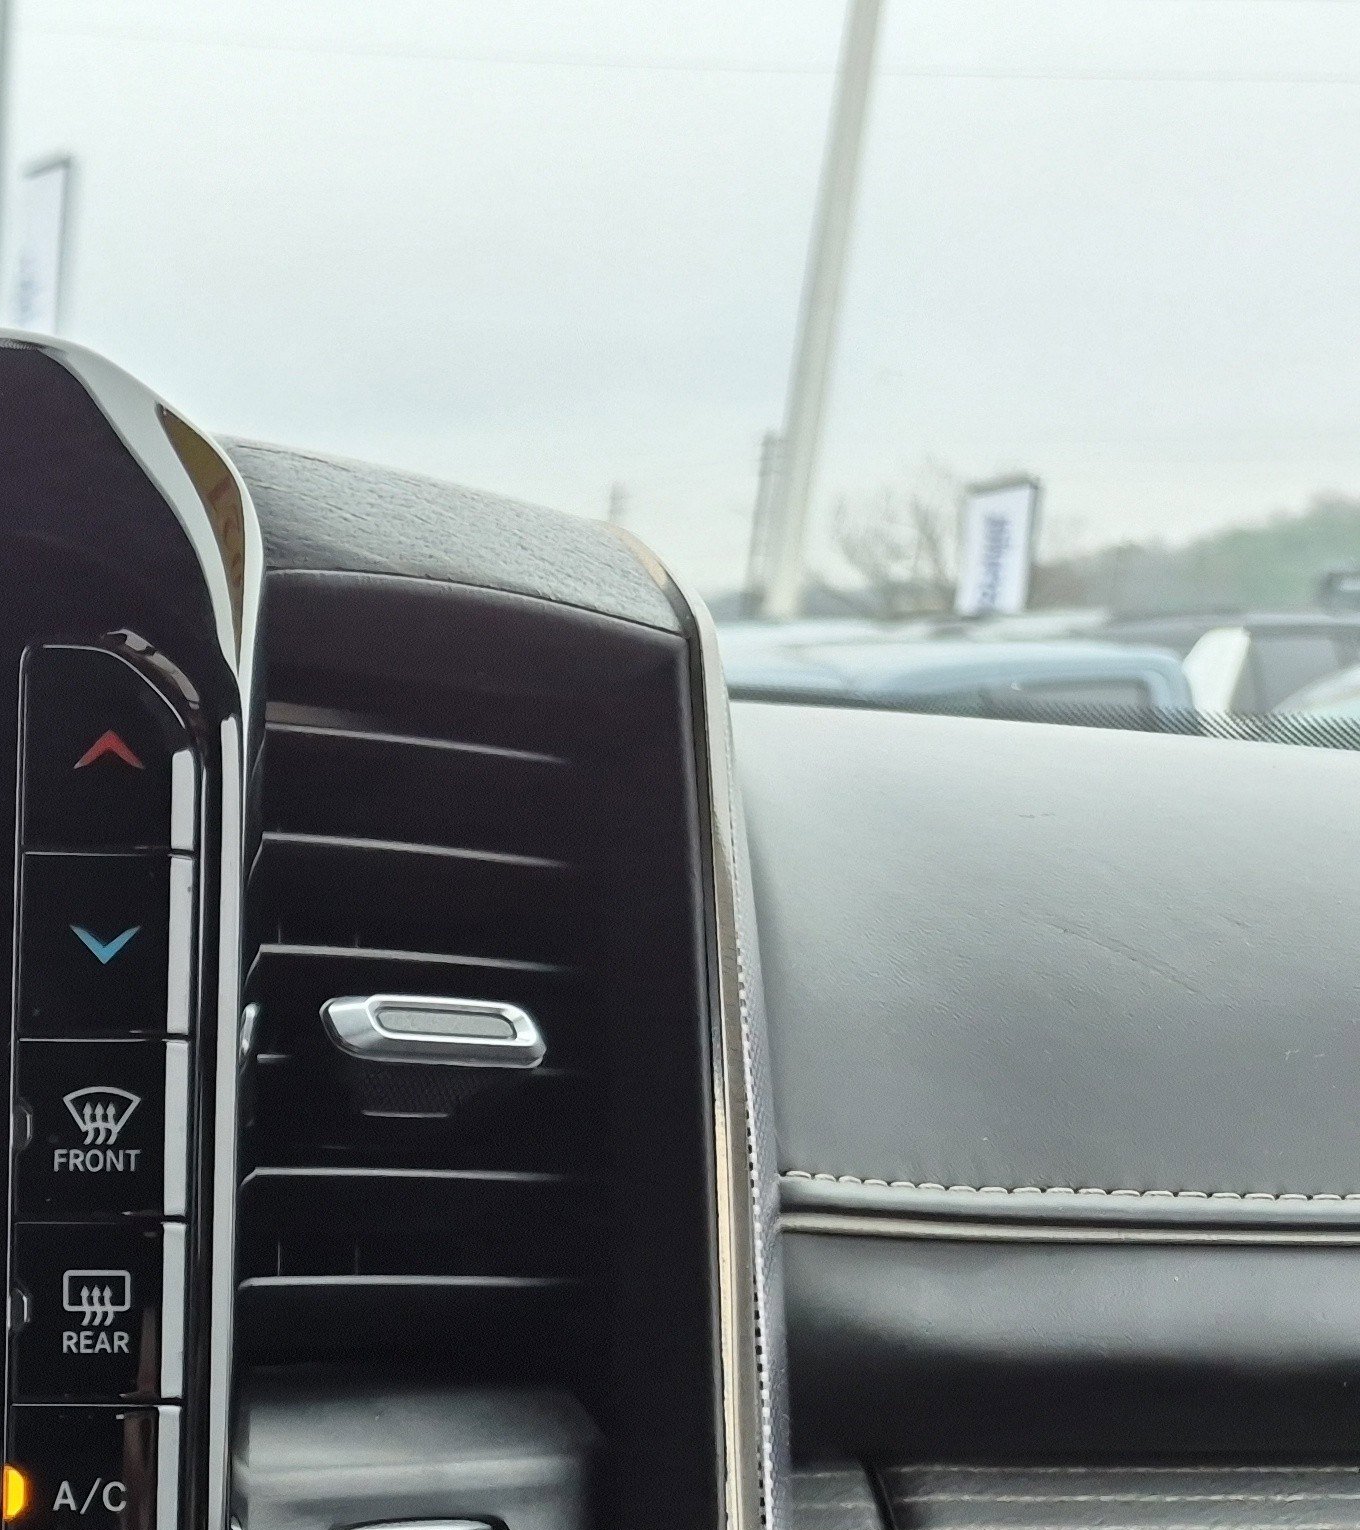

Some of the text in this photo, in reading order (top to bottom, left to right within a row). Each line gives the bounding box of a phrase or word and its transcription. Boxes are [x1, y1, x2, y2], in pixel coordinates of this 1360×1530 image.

[53, 1148, 141, 1173] FRONT
[62, 1330, 130, 1354] REAR
[52, 1477, 127, 1515] A/C
